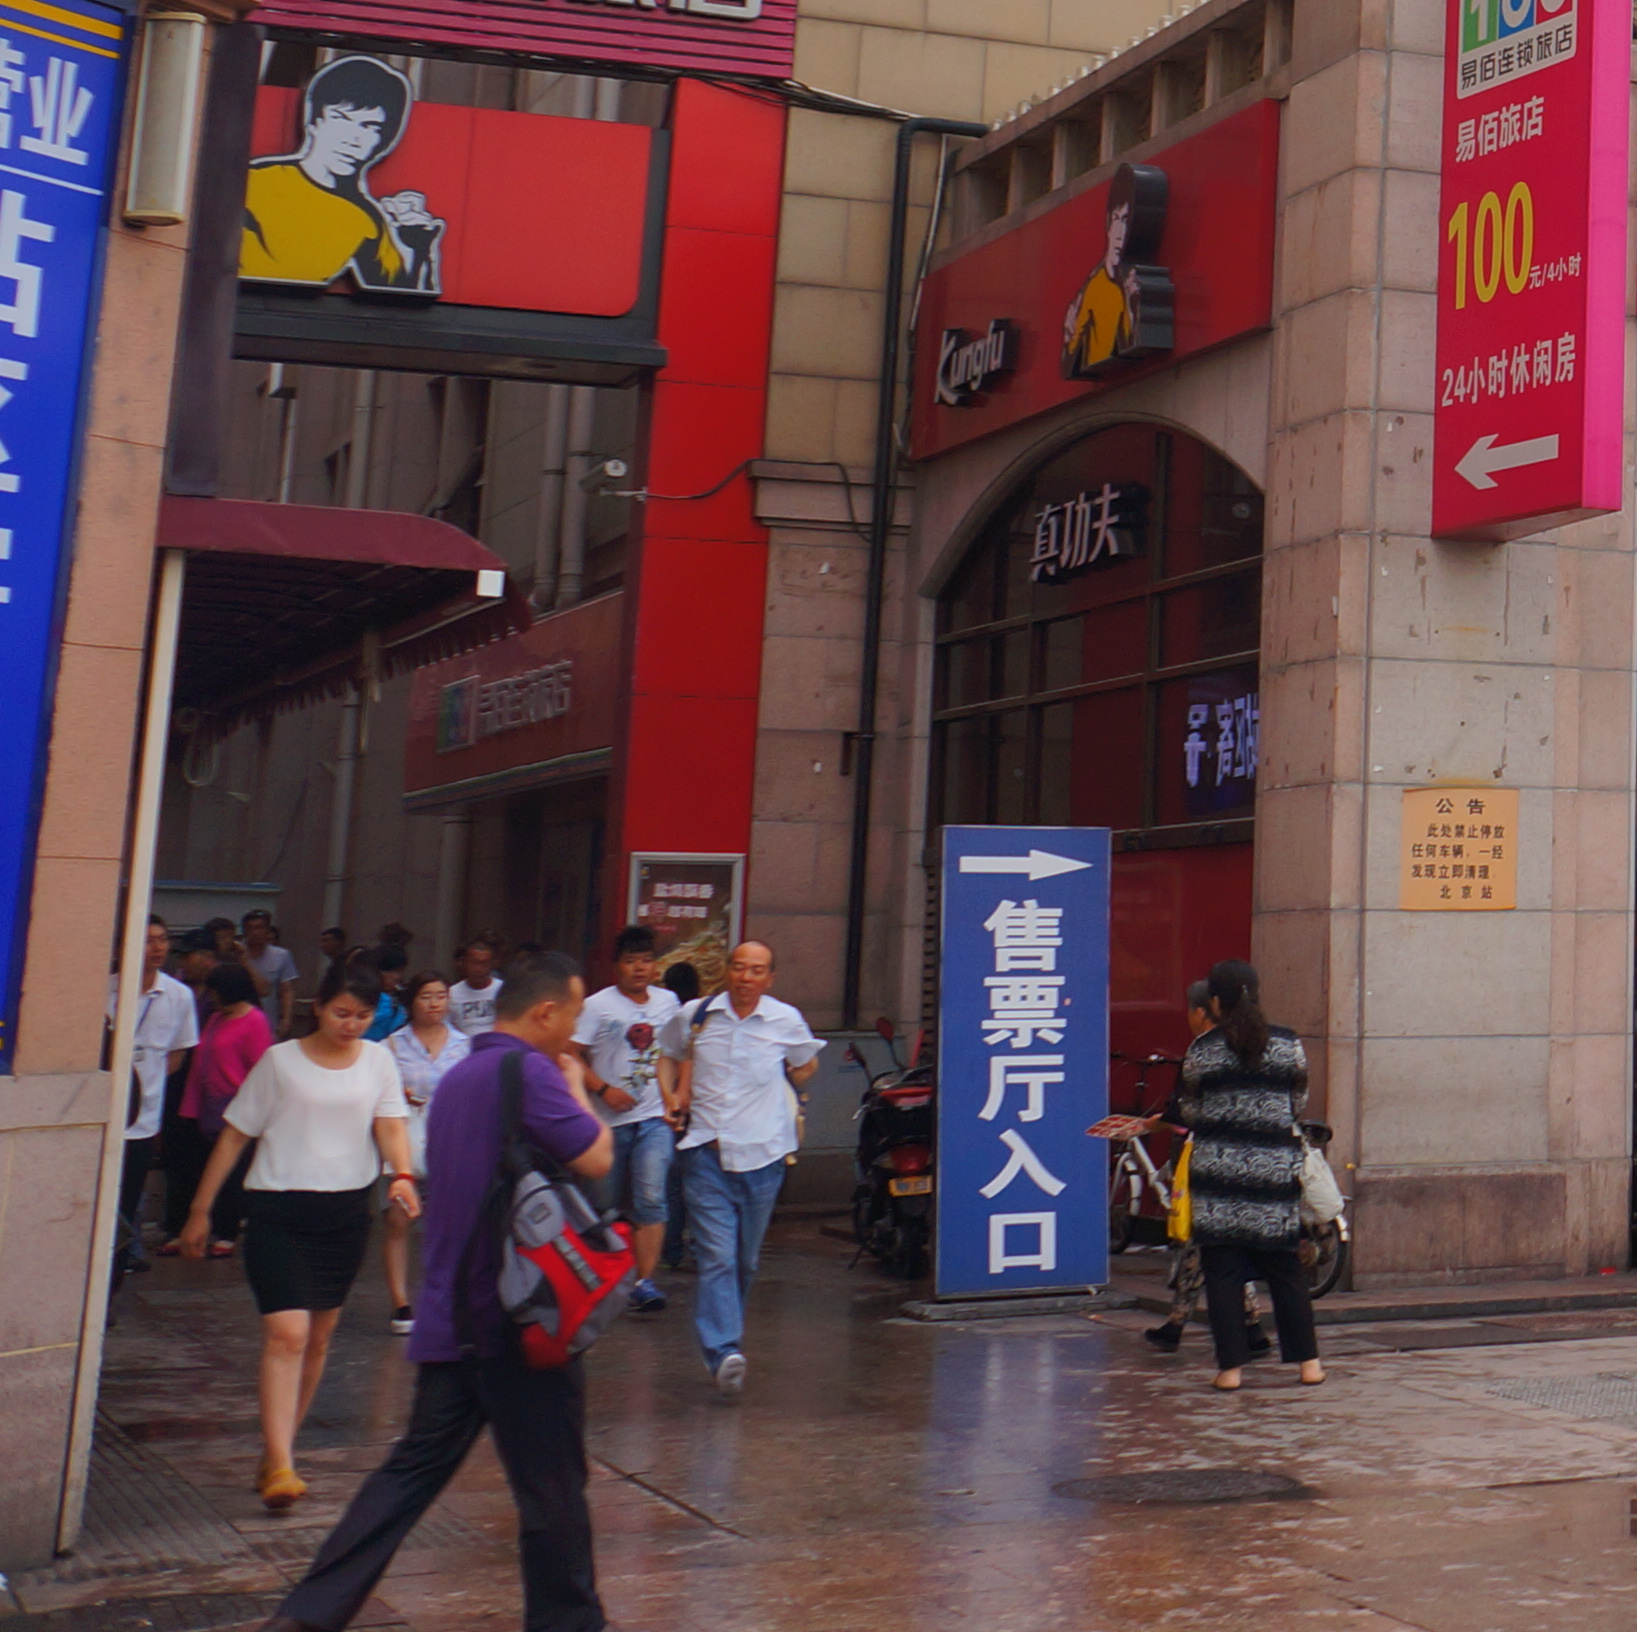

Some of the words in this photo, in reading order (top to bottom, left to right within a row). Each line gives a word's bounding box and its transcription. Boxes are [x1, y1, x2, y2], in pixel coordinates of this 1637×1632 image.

[1461, 23, 1573, 90] 易佰连锁旅店
[1455, 95, 1545, 163] 易佰旅店
[934, 319, 1005, 405] Kungfu
[1441, 331, 1577, 407] 24小时休闲房
[1029, 483, 1120, 581] 真功夫
[1426, 823, 1505, 839] 此处禁止停放
[1435, 797, 1486, 815] 公告
[1440, 885, 1493, 899] 北京站
[977, 899, 1067, 1274] 售票厅入口
